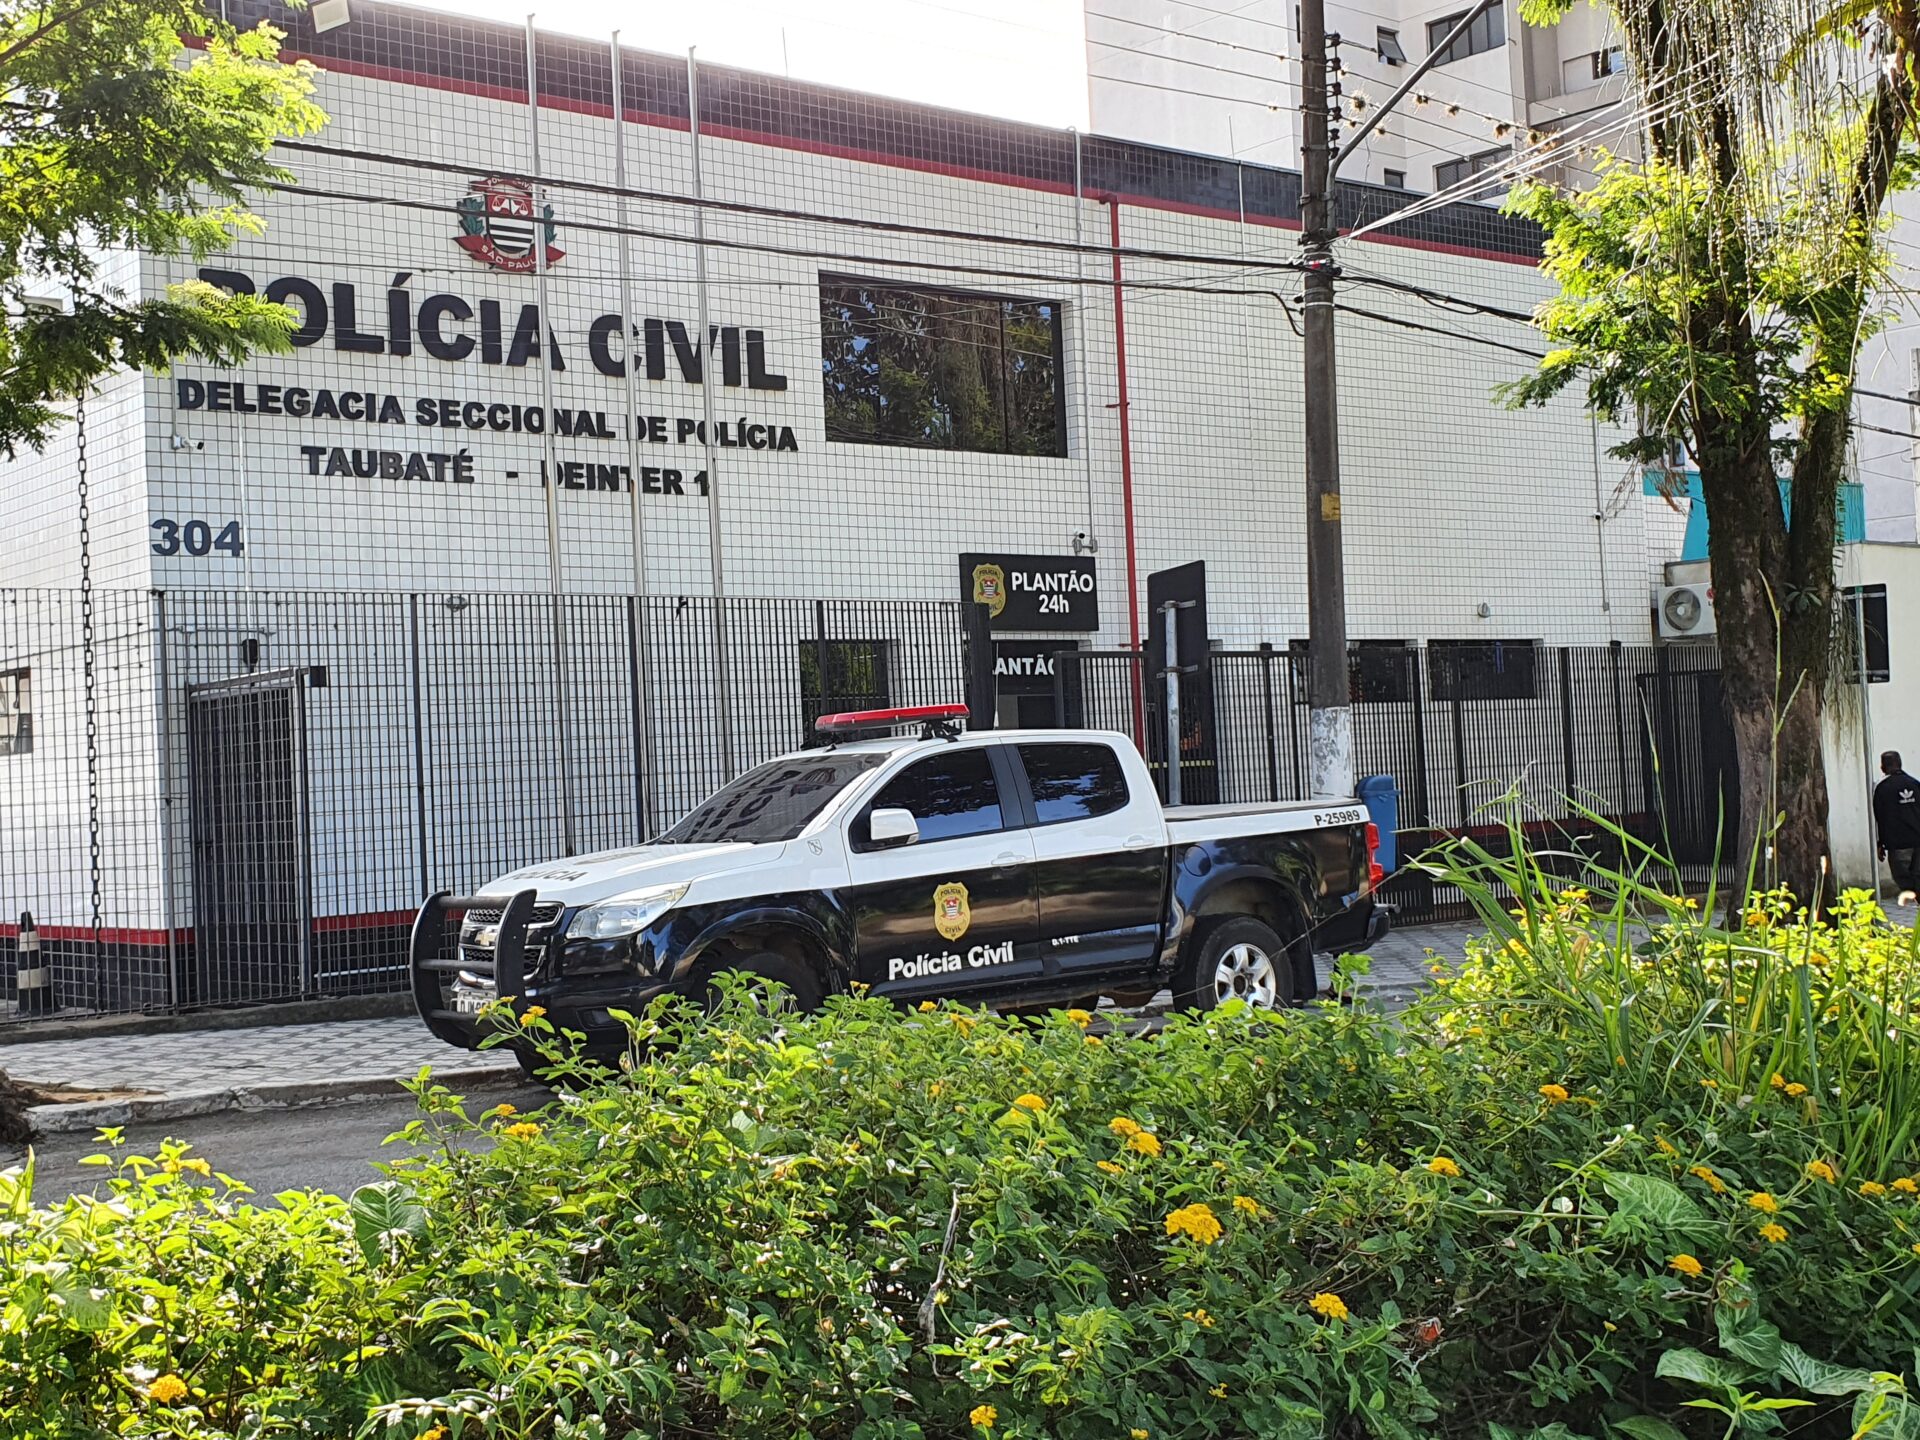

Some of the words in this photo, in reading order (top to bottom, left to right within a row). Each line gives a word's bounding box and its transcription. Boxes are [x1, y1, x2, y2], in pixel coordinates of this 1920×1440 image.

[588, 314, 788, 391] CIVIL
[177, 379, 406, 425] DELEGACIA
[416, 397, 616, 439] SECCIONAL
[300, 446, 475, 484] TAUBATÉ
[694, 470, 709, 497] 1
[151, 518, 244, 557] 304
[1011, 570, 1094, 592] PLANTÃO
[1039, 594, 1069, 613] 24h
[1314, 809, 1360, 826] P-25989
[888, 951, 962, 981] Polícia
[967, 941, 1014, 968] Civil
